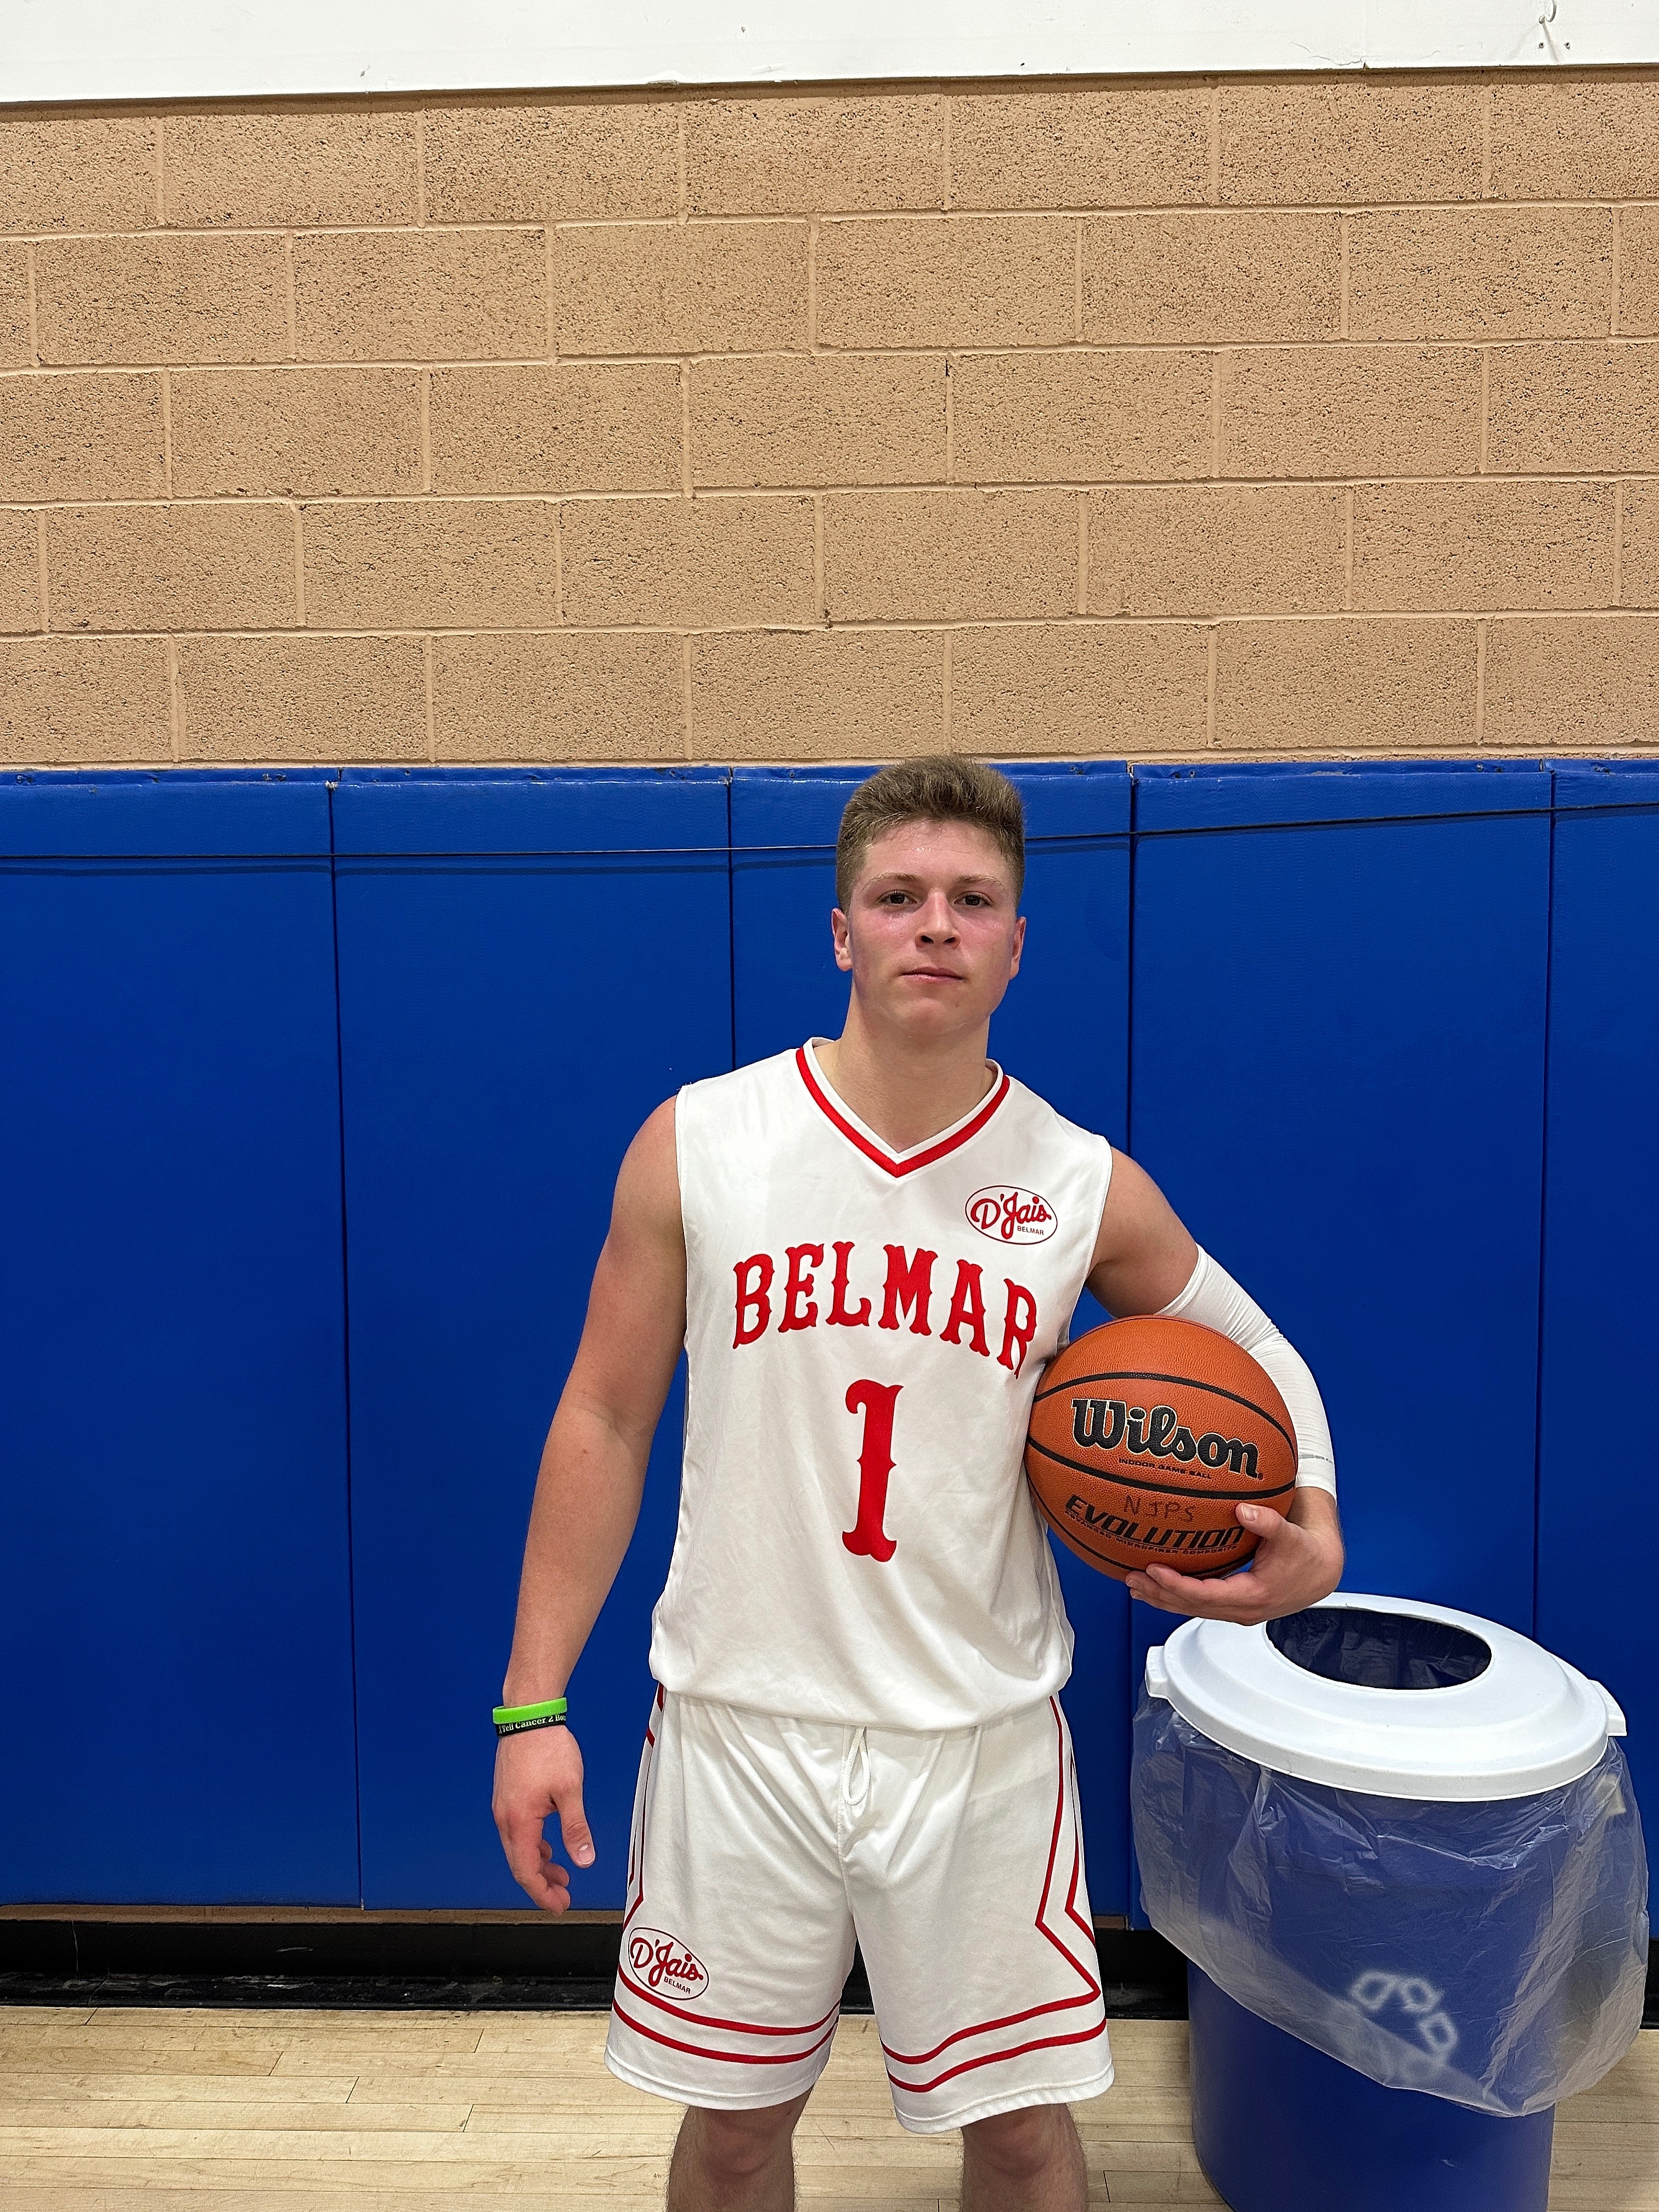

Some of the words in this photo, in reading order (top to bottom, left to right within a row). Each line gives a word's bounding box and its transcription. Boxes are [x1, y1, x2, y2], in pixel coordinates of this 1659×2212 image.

[970, 1192, 1052, 1239] D'Jais
[1017, 1226, 1044, 1235] BELMAR
[732, 1242, 1037, 1379] BELMAR
[1071, 1398, 1259, 1479] Wilson
[842, 1379, 904, 1562] 1
[1119, 1458, 1155, 1468] INDOOR
[1158, 1464, 1186, 1474] GAME
[1189, 1470, 1212, 1479] BALL
[1065, 1494, 1245, 1548] EVOLUTION
[501, 1723, 514, 1733] Tell
[515, 1718, 546, 1729] Cancer
[630, 1937, 704, 1987] D'Jais
[663, 1976, 691, 1994] BELMAR
